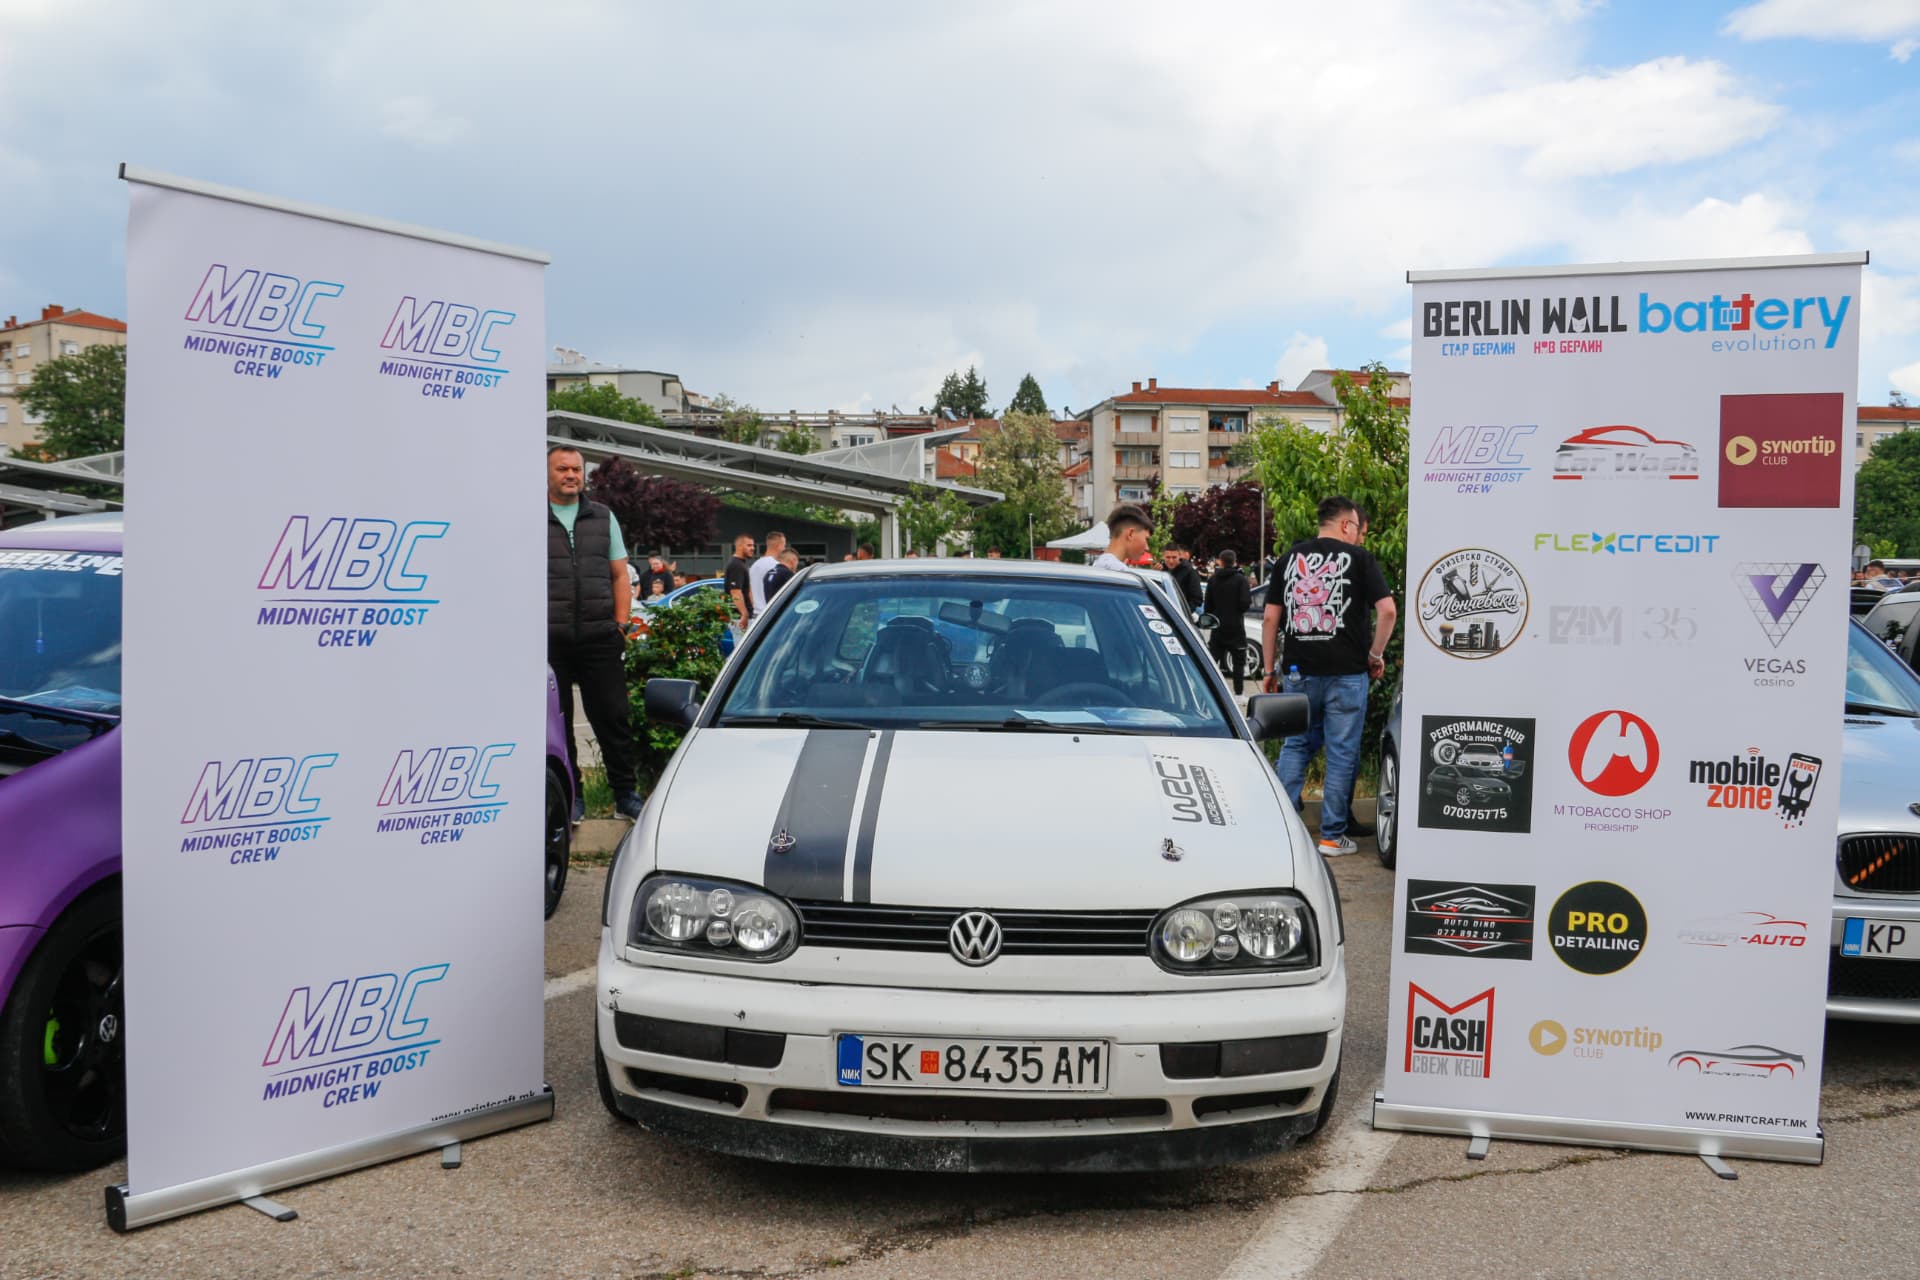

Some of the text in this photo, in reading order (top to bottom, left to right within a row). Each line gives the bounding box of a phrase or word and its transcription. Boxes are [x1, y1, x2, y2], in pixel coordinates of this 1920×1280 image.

[184, 264, 345, 339] MBC
[1424, 296, 1627, 337] BERLIN WALL
[1638, 293, 1852, 349] battery
[379, 296, 516, 363] MBC
[183, 335, 326, 366] MIDNIGHT BOOST
[1711, 333, 1816, 352] evolution
[234, 360, 282, 378] CREW
[380, 361, 501, 388] MIDNIGHT BOOST
[422, 383, 466, 399] CREW
[1424, 425, 1538, 464] MBC
[1762, 456, 1788, 465] CLUB
[1424, 472, 1523, 482] MIDNIGHT BOOST
[1457, 484, 1493, 493] CREW
[256, 515, 451, 592] MBC
[257, 608, 429, 625] MIDNIGHT BOOST
[318, 629, 377, 647] CREW
[1744, 658, 1806, 674] VEGAS
[1754, 676, 1795, 687] casino
[1430, 721, 1525, 744] PERFORMANCE HUB
[1454, 733, 1502, 742] Coka motors
[376, 743, 516, 806] MBC
[1690, 755, 1780, 786] mobile
[1792, 760, 1817, 772] SERVICE
[180, 752, 339, 824] MBC
[1707, 785, 1772, 810] zone
[377, 809, 501, 832] MIDNIGHT BOOST
[1443, 805, 1508, 819] 070375775
[1554, 805, 1672, 820] M TOBACCO SHOP
[181, 825, 322, 852] MIDNIGHT BOOST
[420, 828, 464, 845] CREW
[1584, 823, 1639, 833] PROBISHTIP
[230, 847, 280, 864] CREW
[1568, 911, 1629, 934] PRO
[1437, 928, 1455, 936] 077
[1483, 931, 1502, 940] 037
[1554, 935, 1640, 951] DETAILING
[1867, 924, 1906, 953] KP
[262, 963, 450, 1067] MBC
[1413, 1016, 1486, 1052] CASH
[1573, 1047, 1604, 1058] CLUB
[841, 1068, 861, 1080] NMK
[866, 1043, 1100, 1085] SK 8435 AM
[1412, 1056, 1483, 1077] СВЕЖ КЕШ
[263, 1050, 430, 1100] MIDNIGHT BOOST
[323, 1080, 381, 1108] CREW
[1686, 1111, 1807, 1128] WWW.PRINTCRAFT.MK
